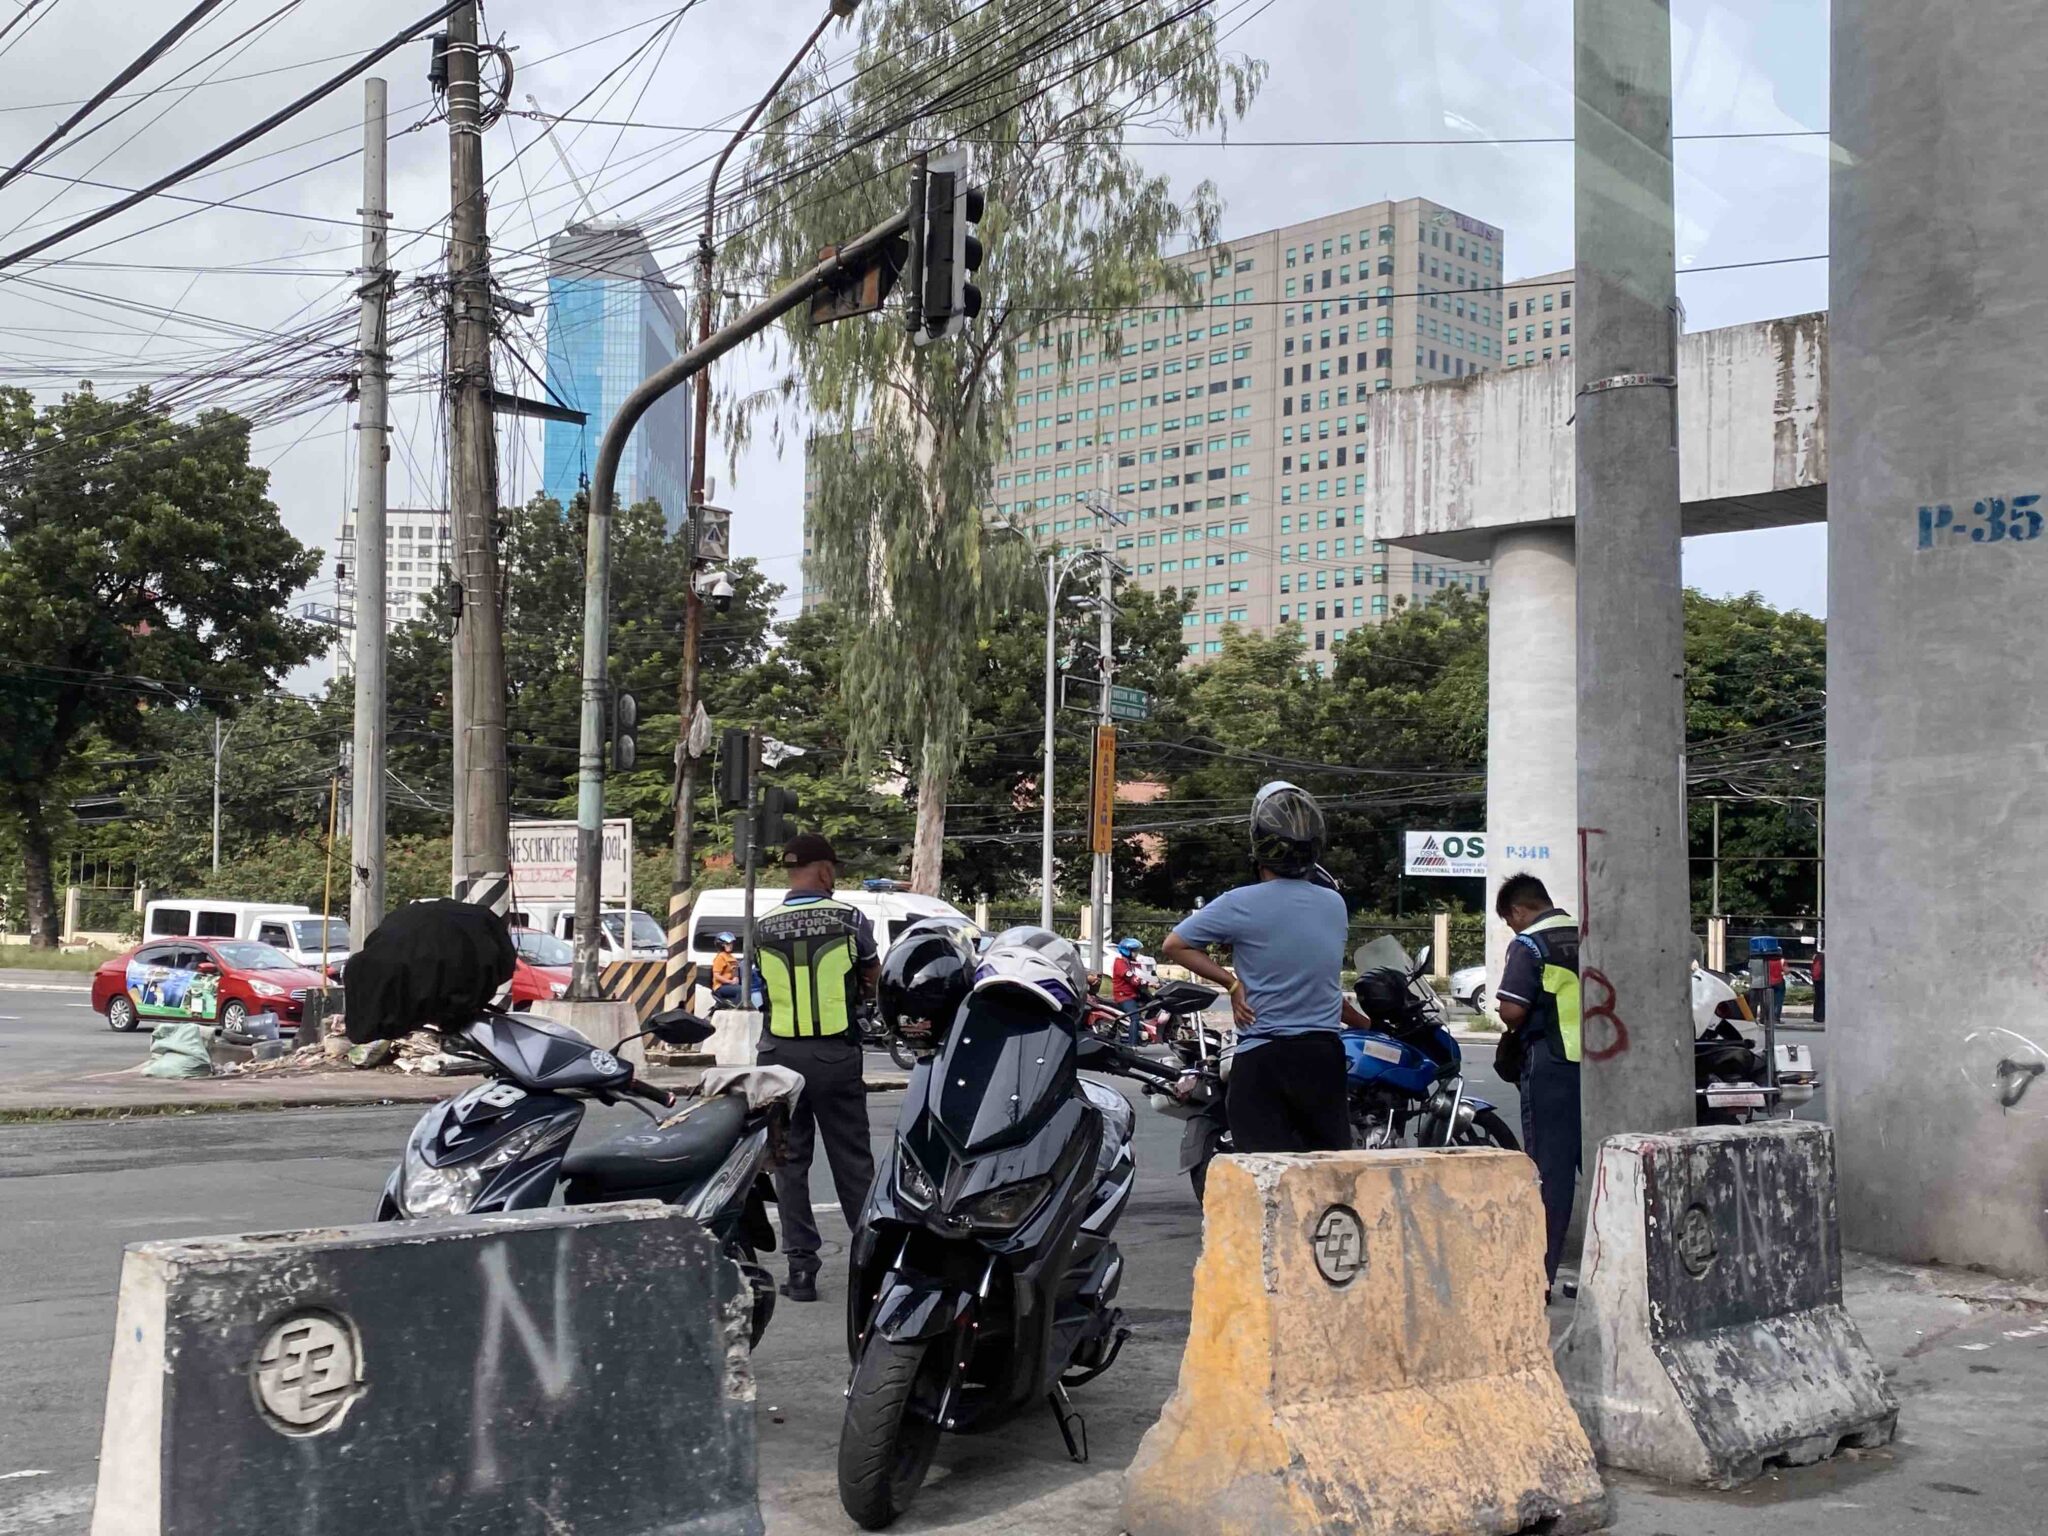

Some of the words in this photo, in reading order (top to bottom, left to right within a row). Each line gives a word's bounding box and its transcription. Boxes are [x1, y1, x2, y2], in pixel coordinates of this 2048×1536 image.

[1916, 494, 2044, 551] P-35
[764, 911, 809, 926] QUEZON
[811, 909, 839, 917] CITY
[764, 922, 795, 933] TASK
[797, 917, 840, 928] FORCE
[774, 926, 826, 940] TTM
[465, 1232, 574, 1492] N
